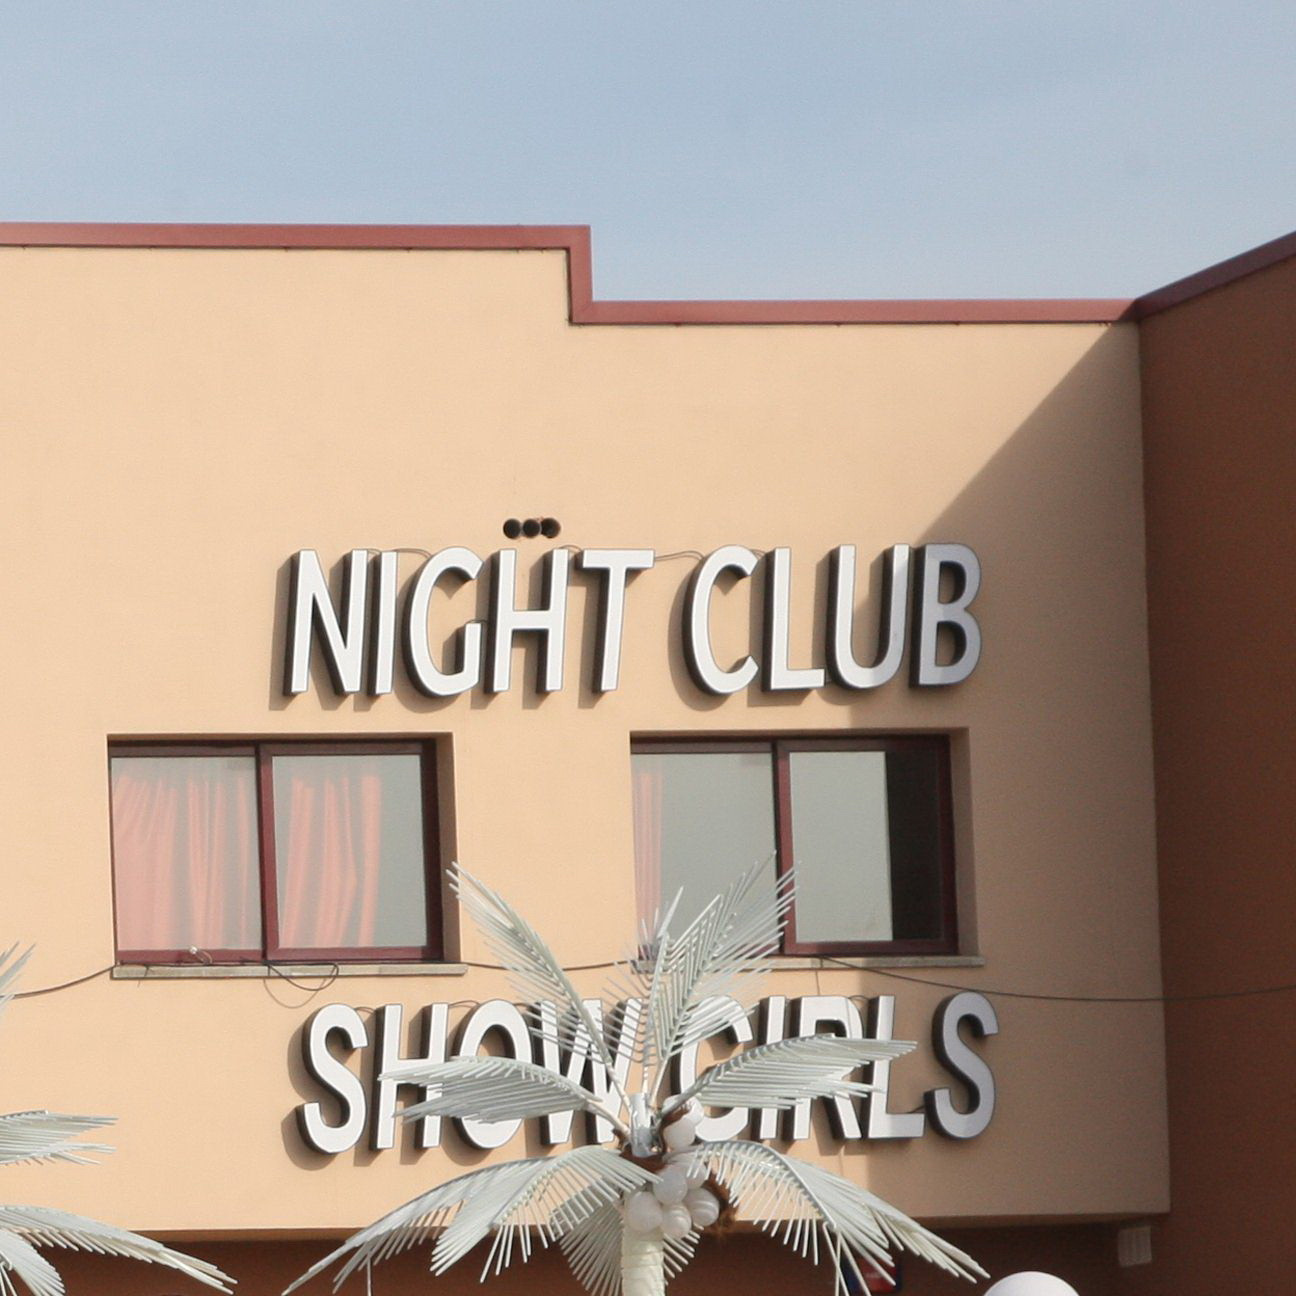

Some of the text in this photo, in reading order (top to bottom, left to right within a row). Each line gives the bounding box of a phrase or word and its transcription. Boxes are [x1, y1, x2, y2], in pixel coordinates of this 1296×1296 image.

[284, 542, 984, 697] NIGHT CLUB
[297, 998, 645, 1155] SHOW
